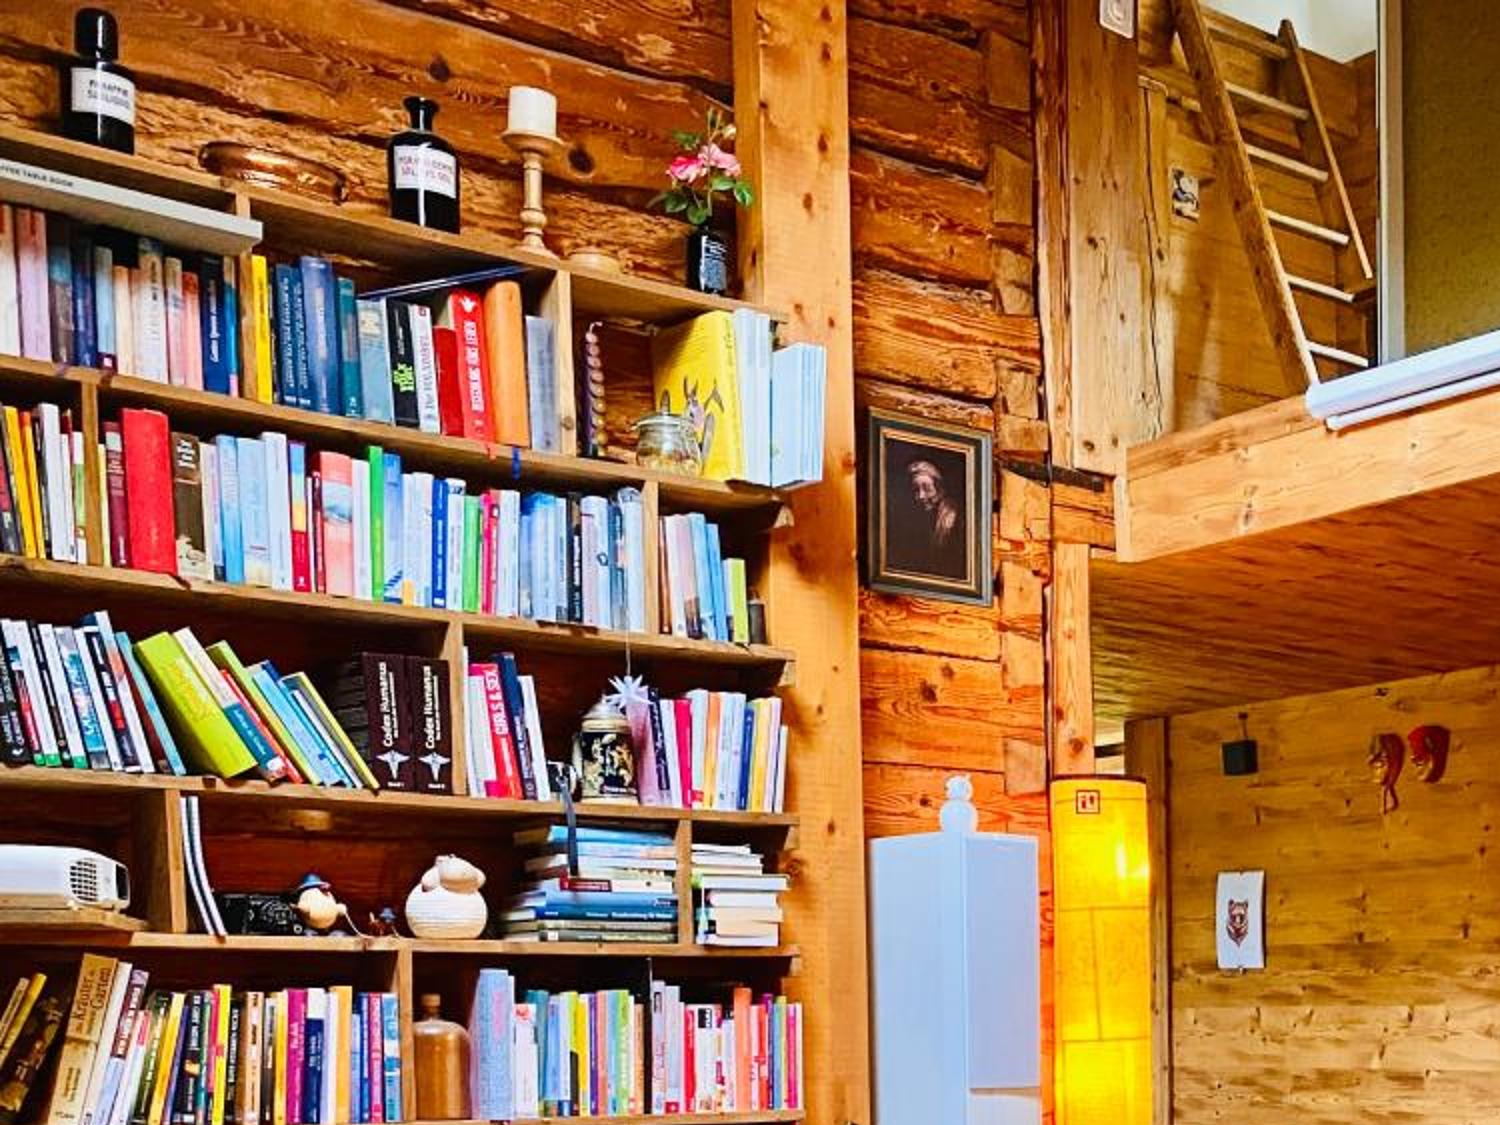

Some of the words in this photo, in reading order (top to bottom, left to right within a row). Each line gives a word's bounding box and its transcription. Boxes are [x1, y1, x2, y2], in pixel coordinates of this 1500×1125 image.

[379, 661, 391, 713] Humanus
[423, 665, 433, 715] Humanus
[381, 713, 393, 747] Codex
[424, 716, 435, 749] Codex
[490, 702, 508, 736] GIRLS
